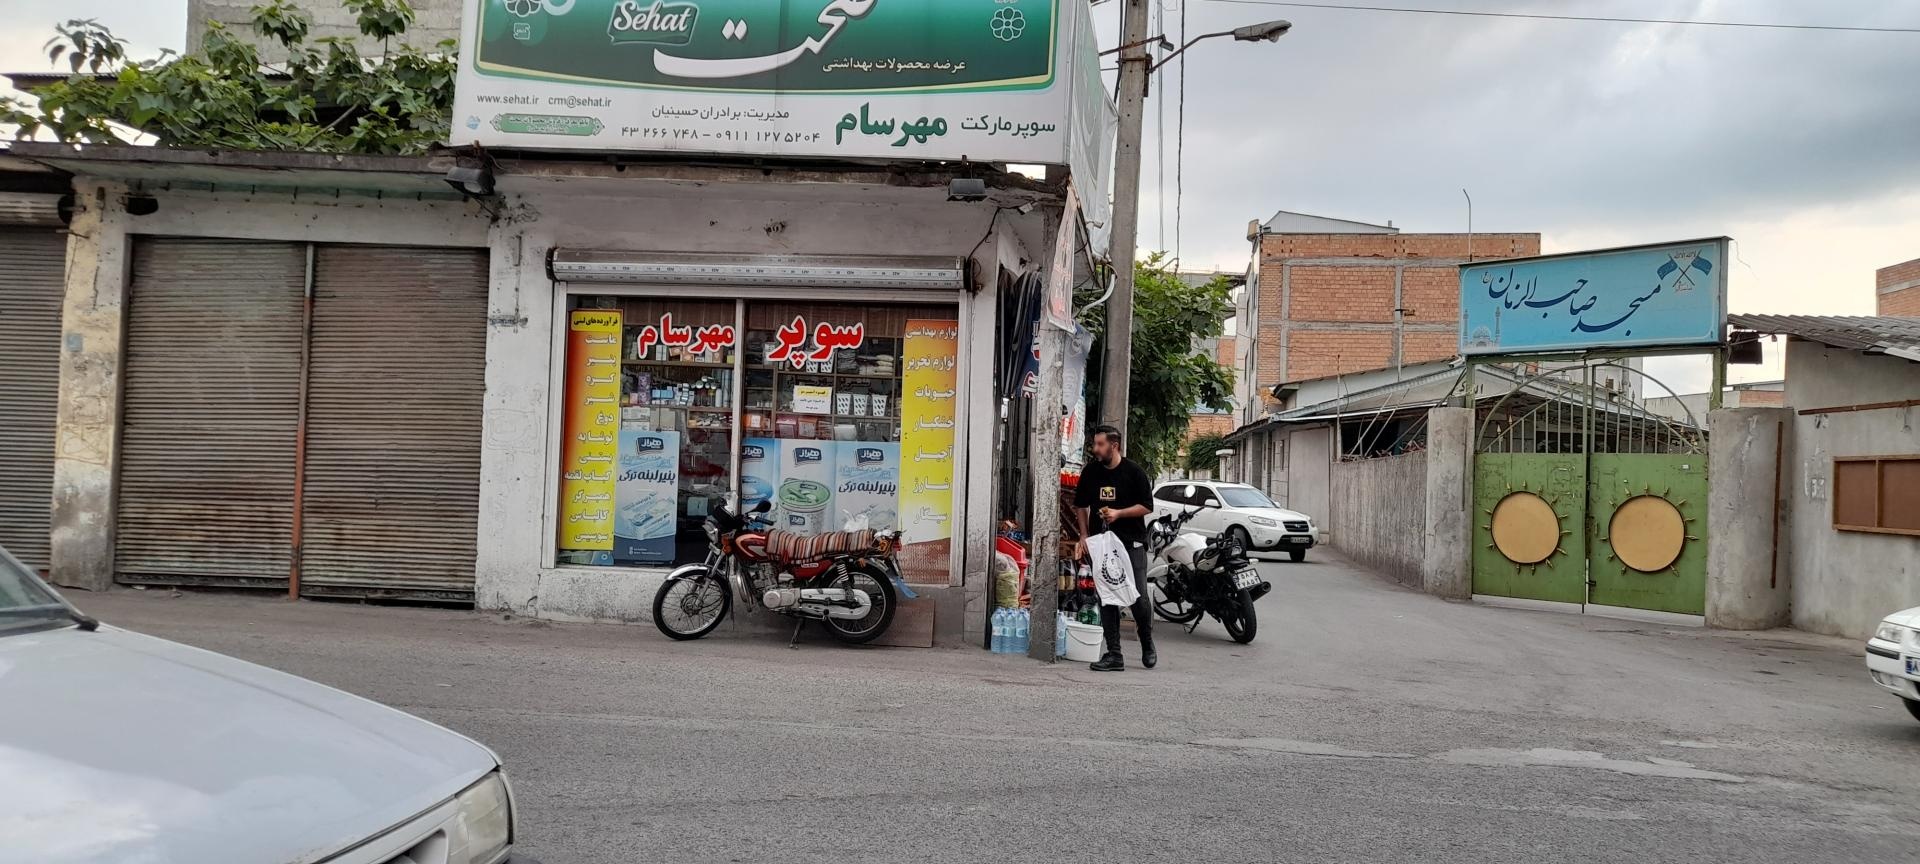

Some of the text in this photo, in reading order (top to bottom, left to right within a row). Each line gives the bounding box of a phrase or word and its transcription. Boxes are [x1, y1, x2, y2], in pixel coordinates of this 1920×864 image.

[613, 1, 692, 32] Sehat
[823, 57, 966, 73] عرضه محصولات بهداشتی
[477, 93, 611, 108] www.sehat.ir crm@sehat.ir
[652, 105, 790, 121] مدیریت: برادران حسینیان
[835, 102, 948, 147] مهرسام
[1488, 267, 1537, 310] الزمان
[1524, 278, 1597, 319] صاحب
[1571, 284, 1662, 336] مسجد
[585, 333, 616, 344] ماست
[637, 311, 864, 370] سوپر مهرسام
[585, 374, 615, 386] کره
[659, 470, 676, 485] پنیر
[569, 508, 609, 522] کالباس
